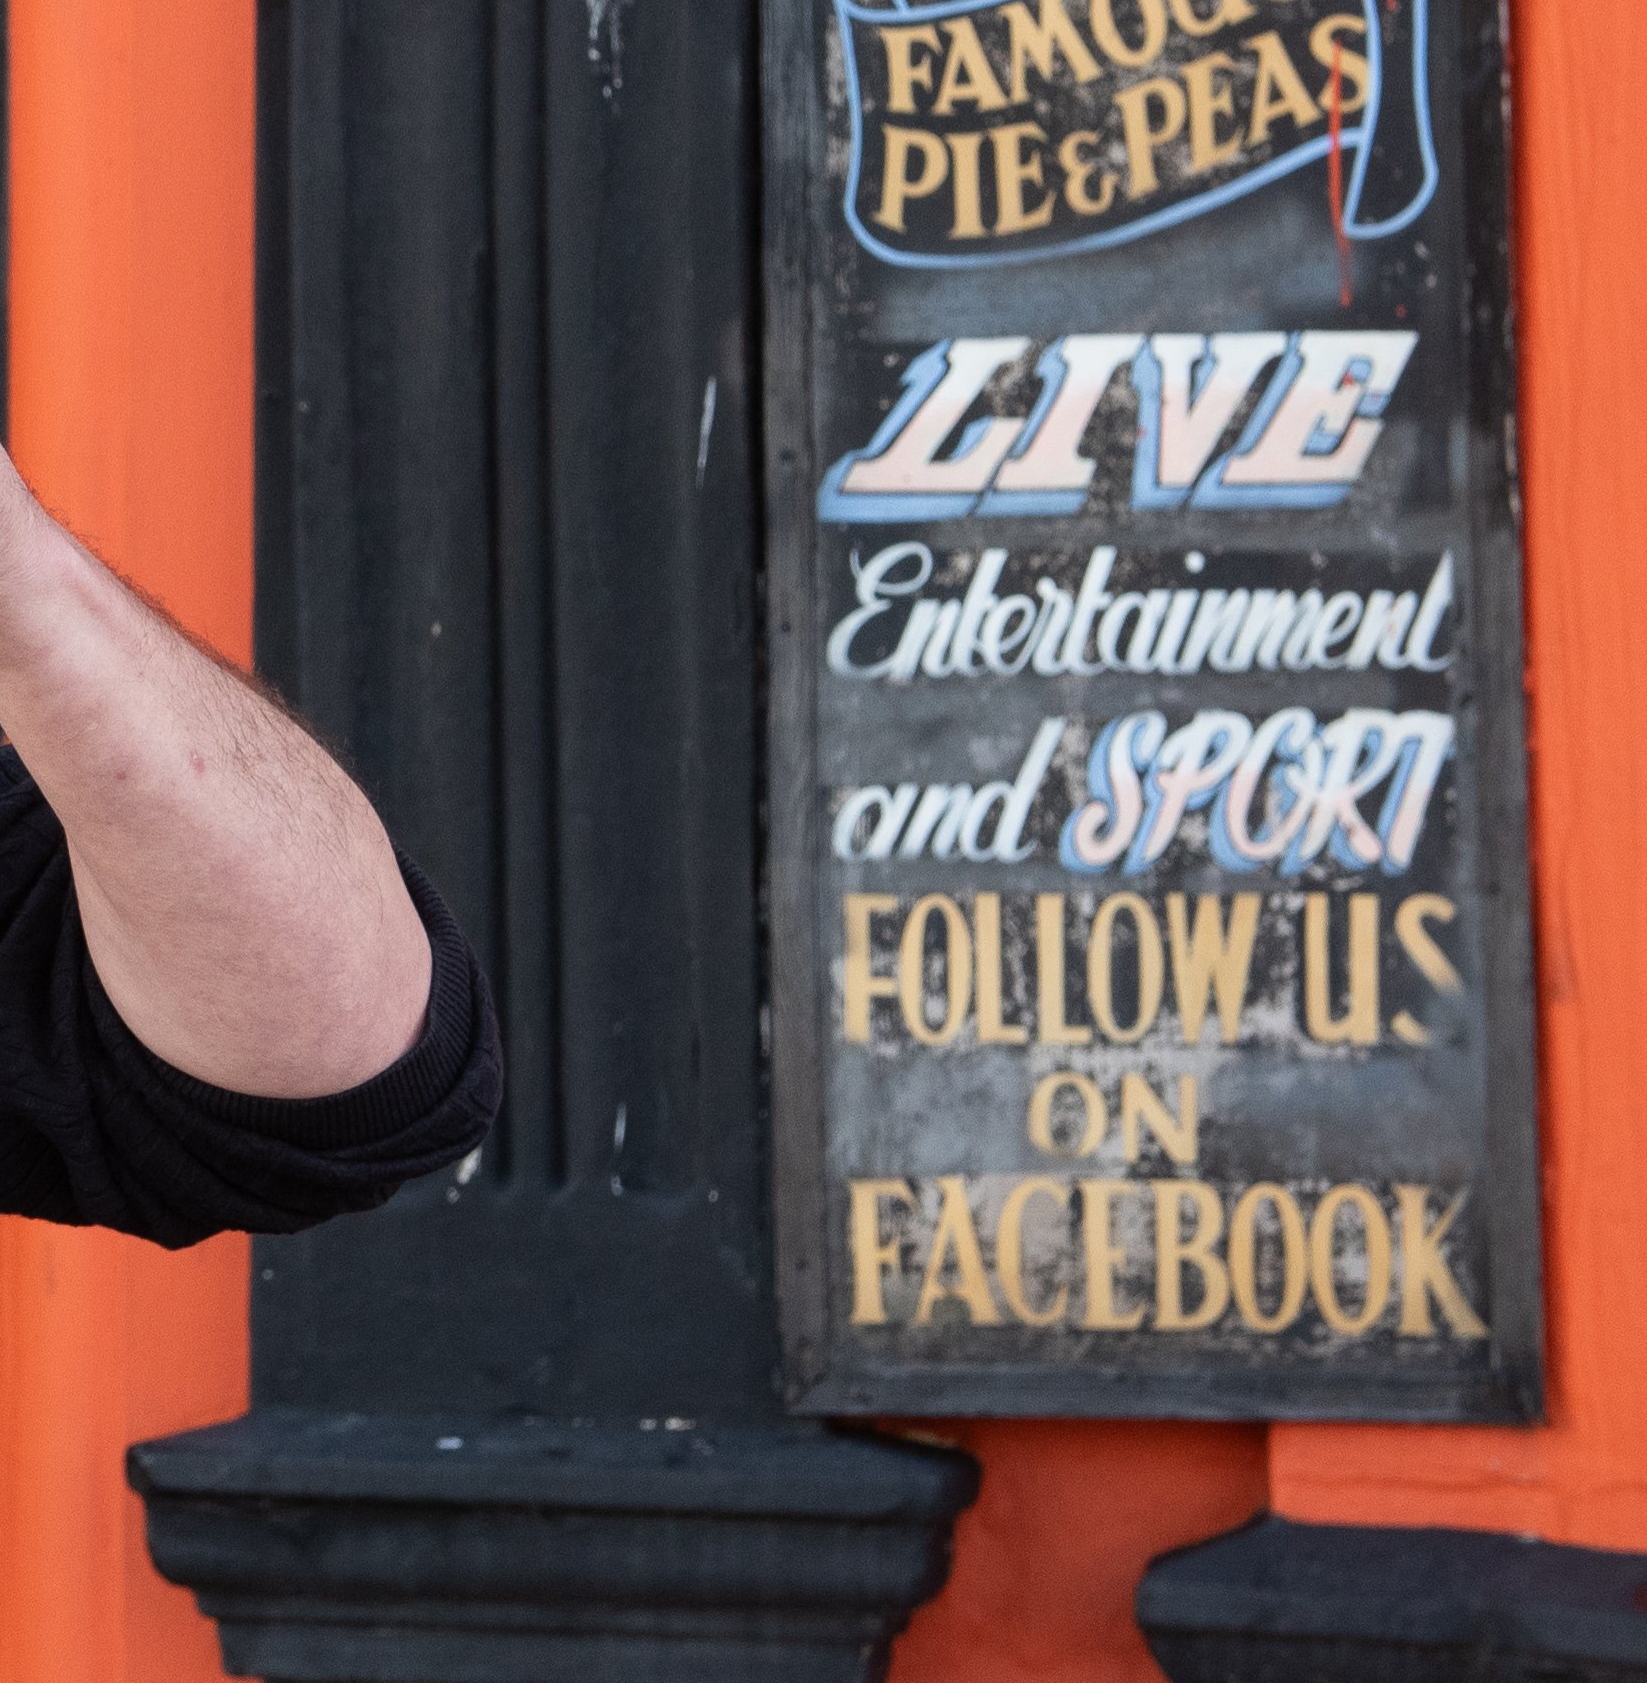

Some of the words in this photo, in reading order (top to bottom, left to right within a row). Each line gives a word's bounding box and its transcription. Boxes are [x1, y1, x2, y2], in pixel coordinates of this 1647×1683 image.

[817, 330, 1418, 524] LIVE
[826, 540, 1457, 682] Entertainment
[833, 717, 1066, 865] and
[1059, 709, 1457, 876] SPORT
[842, 892, 1262, 1046] FOLLOW
[1303, 892, 1465, 1047] US
[1027, 1070, 1200, 1166] ON
[846, 1175, 1491, 1340] FACEBOOK
